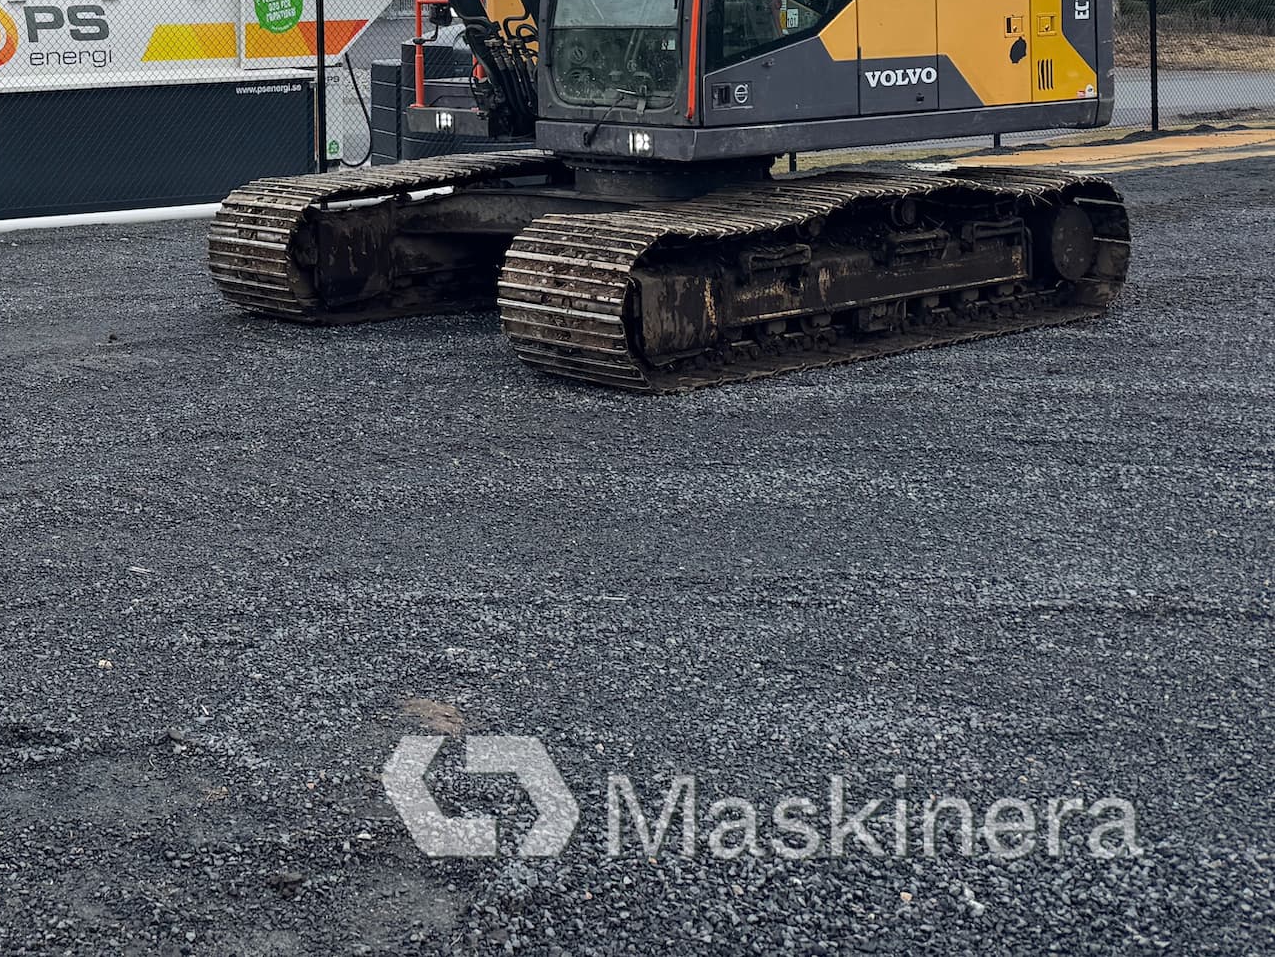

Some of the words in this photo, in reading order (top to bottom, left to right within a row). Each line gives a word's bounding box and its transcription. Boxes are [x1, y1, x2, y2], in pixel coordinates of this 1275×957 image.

[24, 5, 109, 42] PS
[29, 45, 112, 68] energi
[235, 83, 302, 94] www.psenergi.se
[865, 67, 937, 88] VOLVO
